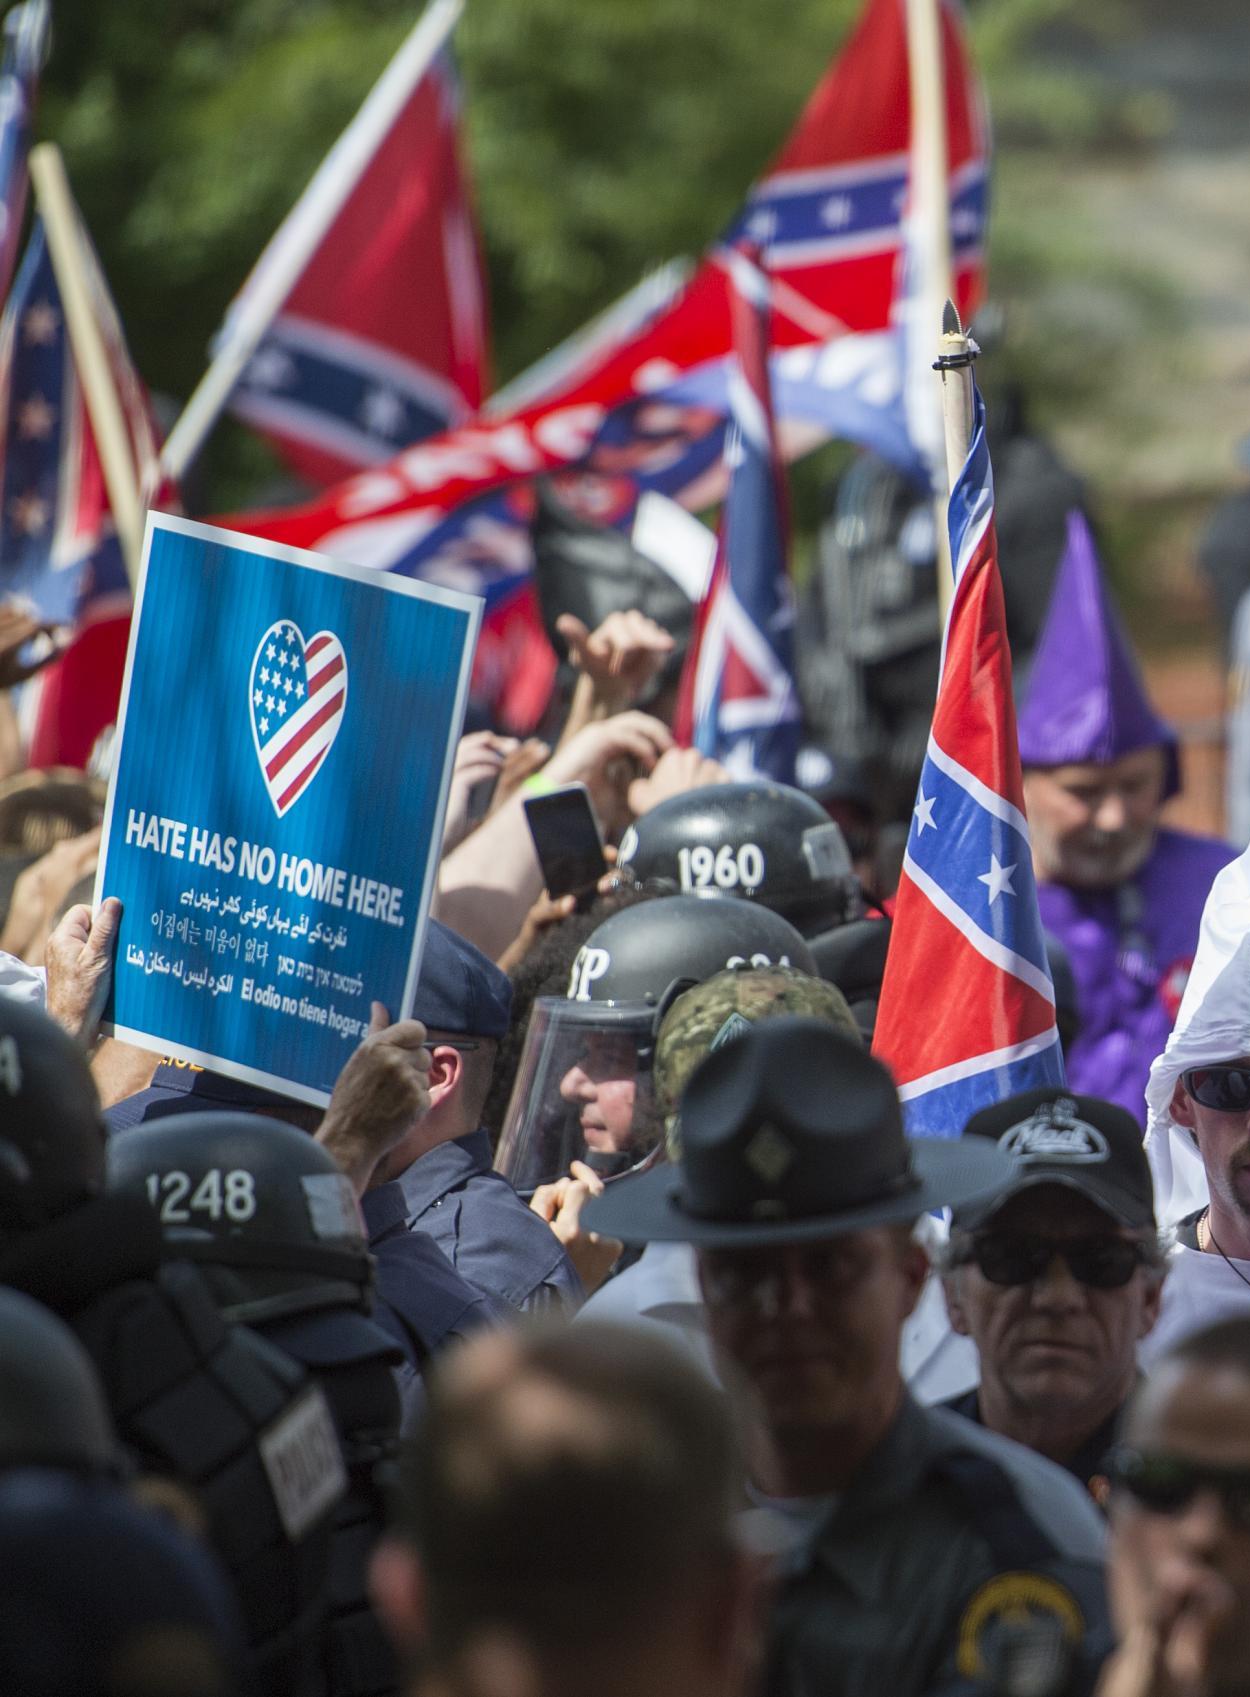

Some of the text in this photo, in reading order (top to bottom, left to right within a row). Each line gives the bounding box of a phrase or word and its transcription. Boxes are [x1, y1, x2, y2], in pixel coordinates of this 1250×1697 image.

[125, 808, 405, 927] HATE HAS NO HOME HERE.
[678, 843, 765, 894] 1960
[205, 925, 242, 959] 미움이
[245, 937, 269, 967] 없다
[241, 977, 254, 1001] El
[254, 984, 280, 1010] odio
[281, 996, 298, 1015] no
[298, 997, 328, 1025] tiene
[327, 1004, 361, 1039] hogar
